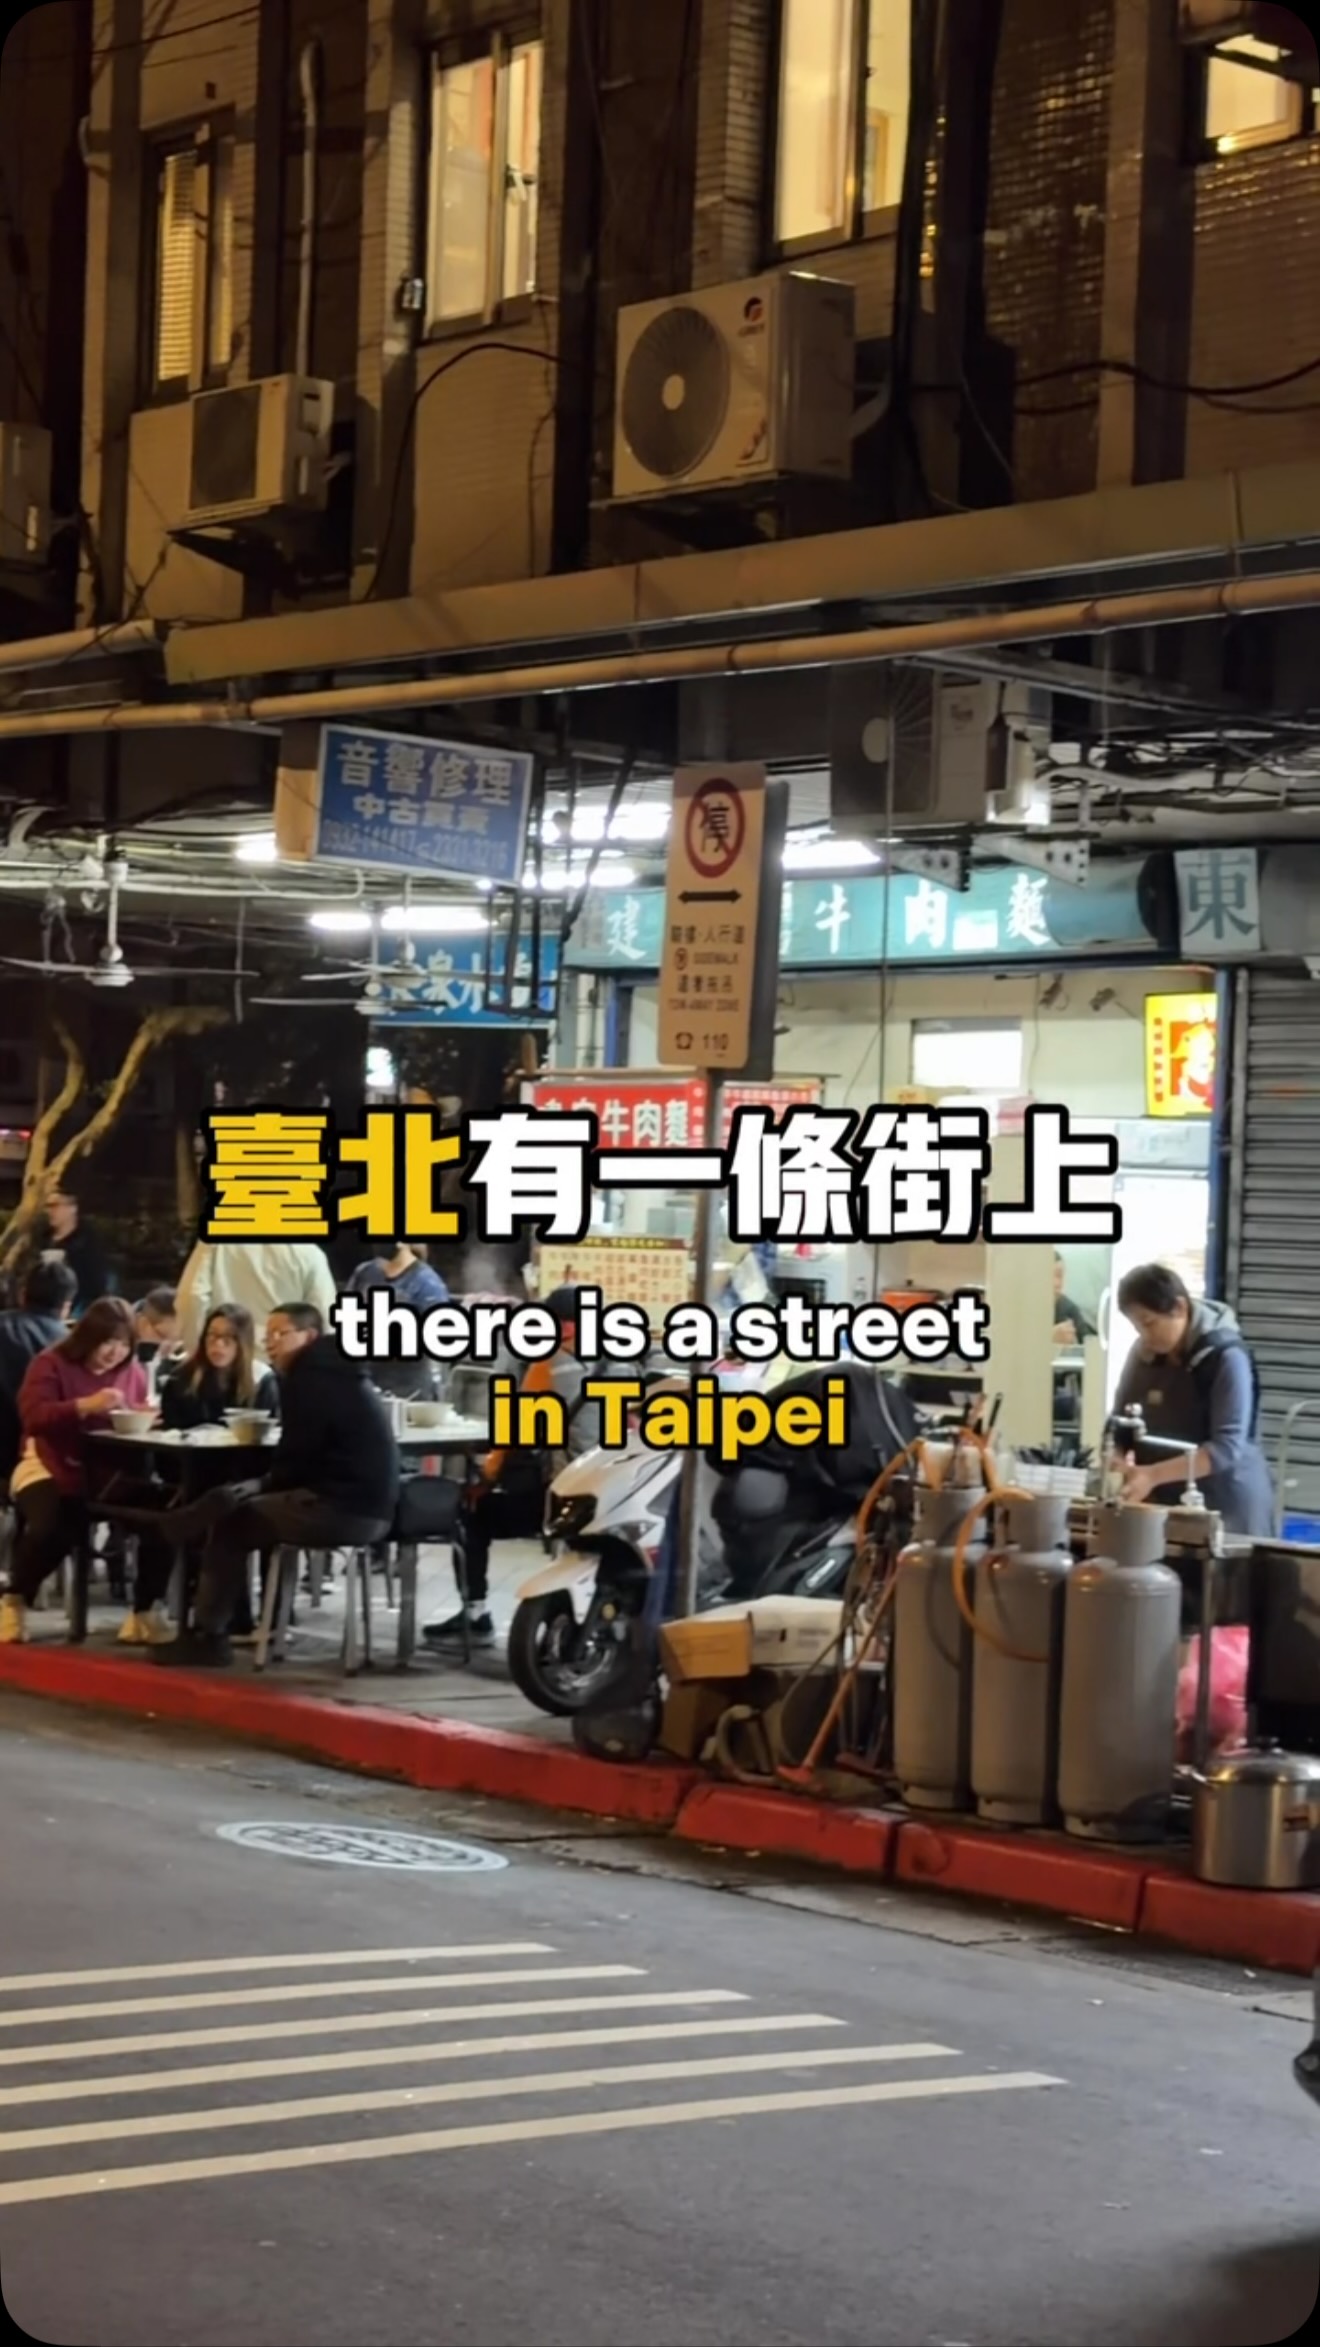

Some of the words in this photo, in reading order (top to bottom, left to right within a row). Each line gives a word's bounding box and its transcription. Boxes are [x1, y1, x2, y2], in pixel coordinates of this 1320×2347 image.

[337, 740, 513, 807] 音響修理
[1180, 852, 1258, 939] 東
